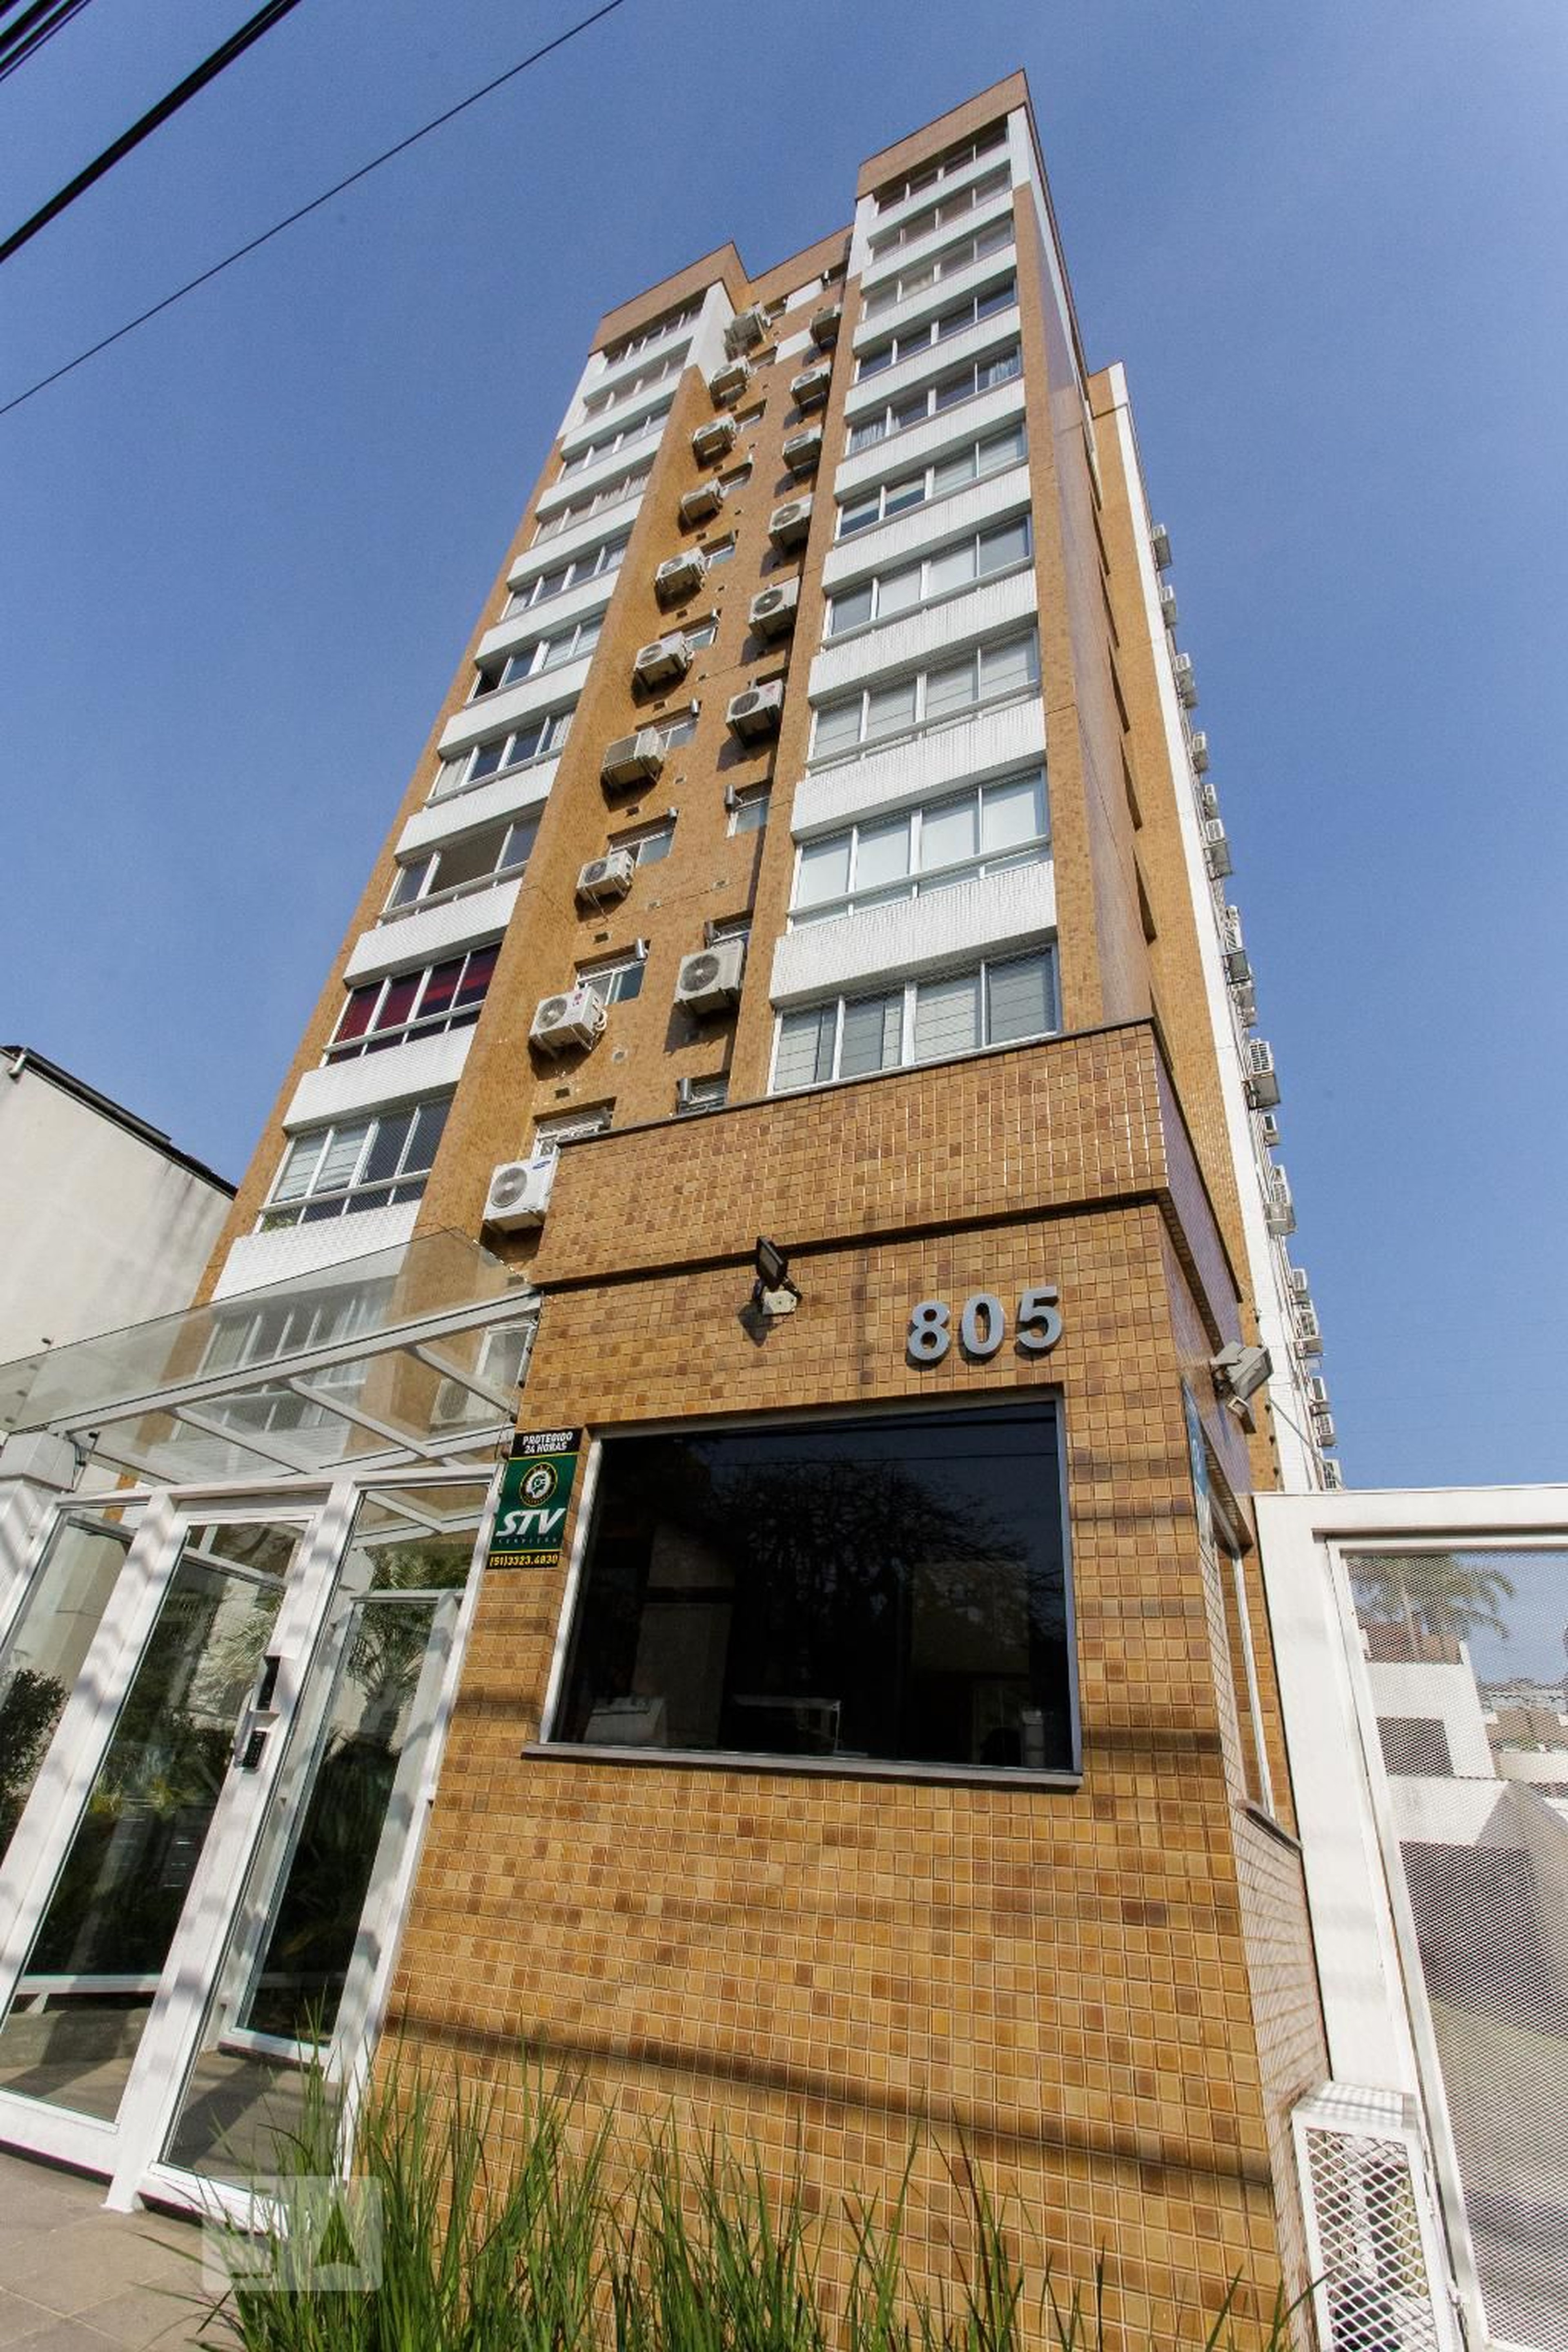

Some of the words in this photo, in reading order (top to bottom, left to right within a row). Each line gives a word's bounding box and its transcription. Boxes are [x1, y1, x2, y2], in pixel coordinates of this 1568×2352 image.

[908, 1286, 1062, 1360] 805
[523, 1431, 573, 1446] PROTEGIDO
[524, 1445, 535, 1454] 24
[537, 1441, 568, 1453] HORAS
[495, 1508, 566, 1536] STV
